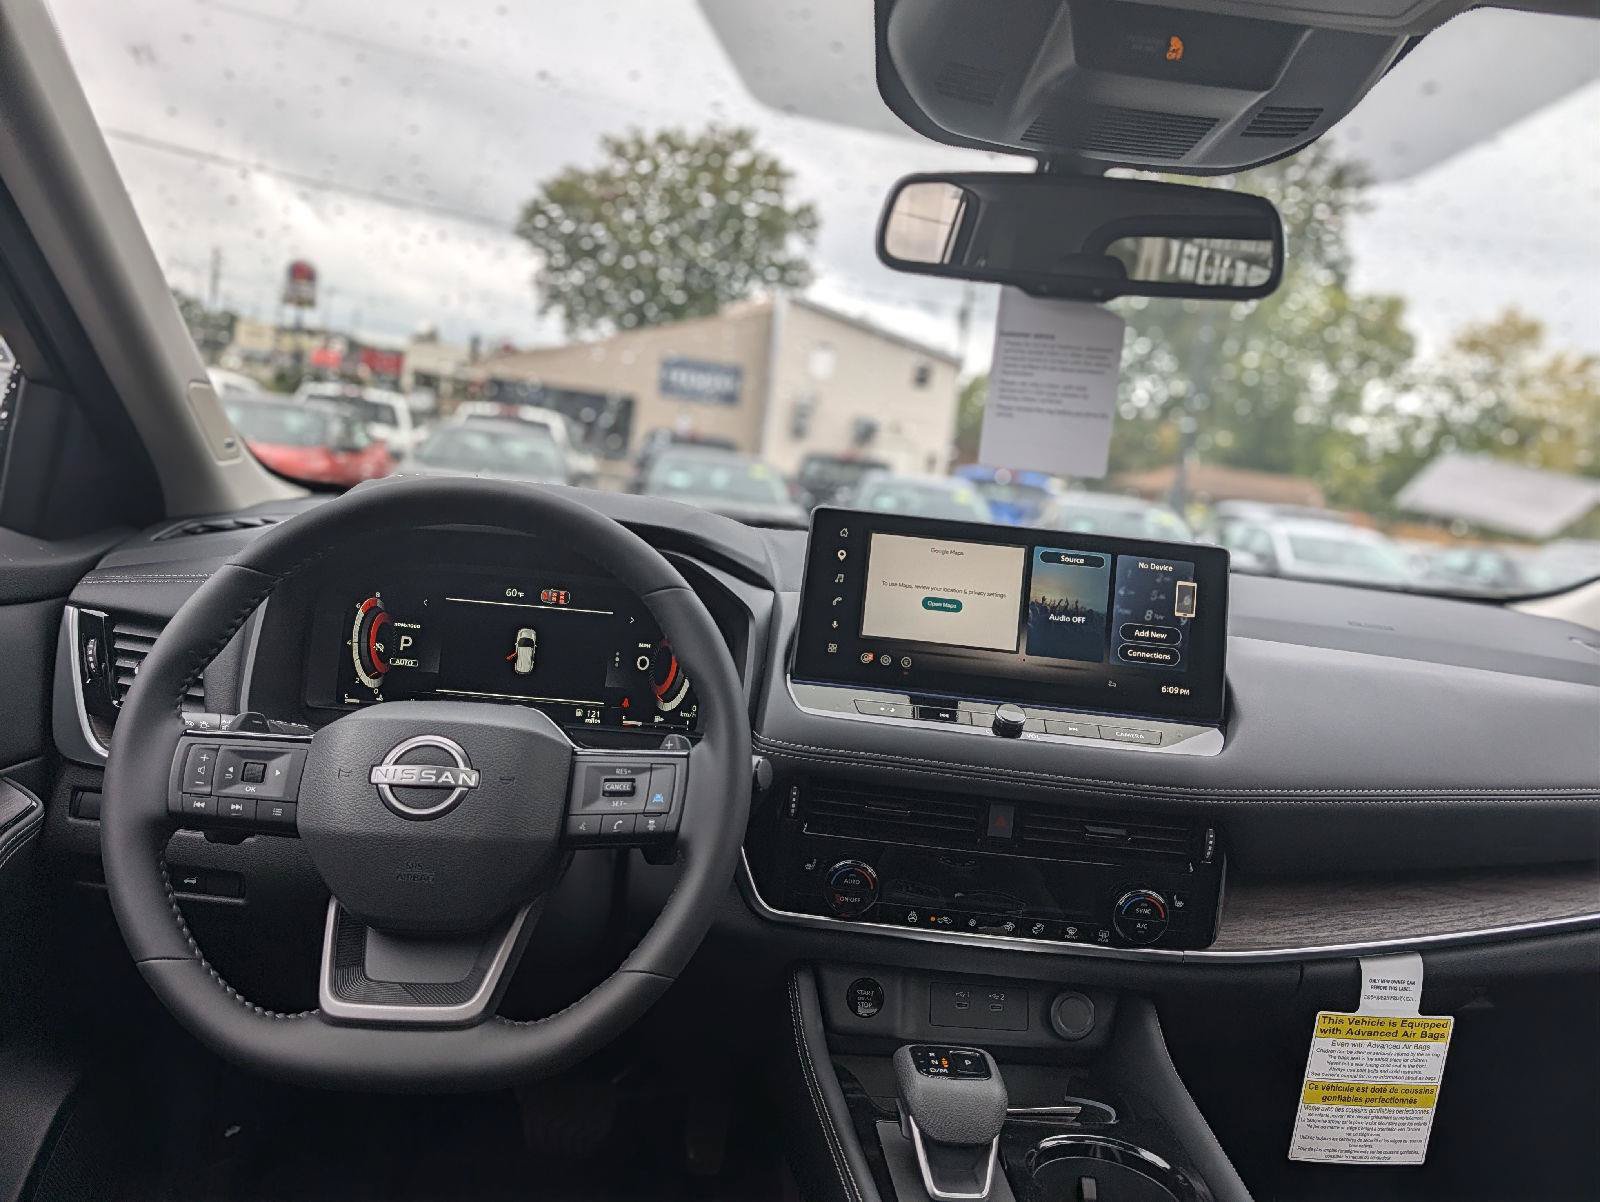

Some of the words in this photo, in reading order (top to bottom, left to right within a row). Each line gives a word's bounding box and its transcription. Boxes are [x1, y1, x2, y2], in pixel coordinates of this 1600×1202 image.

[931, 547, 949, 556] Google
[950, 549, 964, 557] Maps
[1060, 554, 1085, 564] Source
[1138, 561, 1149, 570] No
[1150, 562, 1173, 572] Device
[942, 586, 963, 594] location
[968, 589, 986, 597] privacy
[927, 600, 942, 608] Open
[1049, 612, 1071, 623] Audio
[1071, 615, 1086, 624] OFF
[1134, 628, 1150, 638] Add
[1150, 630, 1168, 639] New
[400, 635, 413, 651] P
[1127, 649, 1171, 661] Connections
[1161, 685, 1179, 695] 6:09
[1179, 688, 1190, 696] PM
[586, 709, 600, 718] 121
[1115, 730, 1145, 740] CAMERA
[373, 767, 477, 787] NISSAN
[245, 785, 256, 793] OK
[605, 783, 631, 791] CANCEL
[1135, 907, 1152, 915] SYNC
[1321, 1015, 1344, 1025] This
[1347, 1017, 1386, 1027] Vehicle
[1388, 1019, 1397, 1028] is
[1400, 1019, 1448, 1030] Equipped
[1319, 1027, 1342, 1035] with
[1345, 1028, 1398, 1038] Advanced
[1401, 1030, 1416, 1038] Air
[1420, 1030, 1446, 1041] Bags
[1331, 1039, 1350, 1048] Even
[1366, 1041, 1401, 1050] Advanced
[1413, 1043, 1431, 1051] Bags
[1308, 1082, 1319, 1091] Ce
[1321, 1083, 1355, 1093] véhicule
[1355, 1086, 1368, 1094] est
[1388, 1086, 1399, 1094] de
[1400, 1086, 1435, 1095] coussins
[1321, 1094, 1363, 1103] gonflables
[1364, 1095, 1418, 1105] perfectionnés
